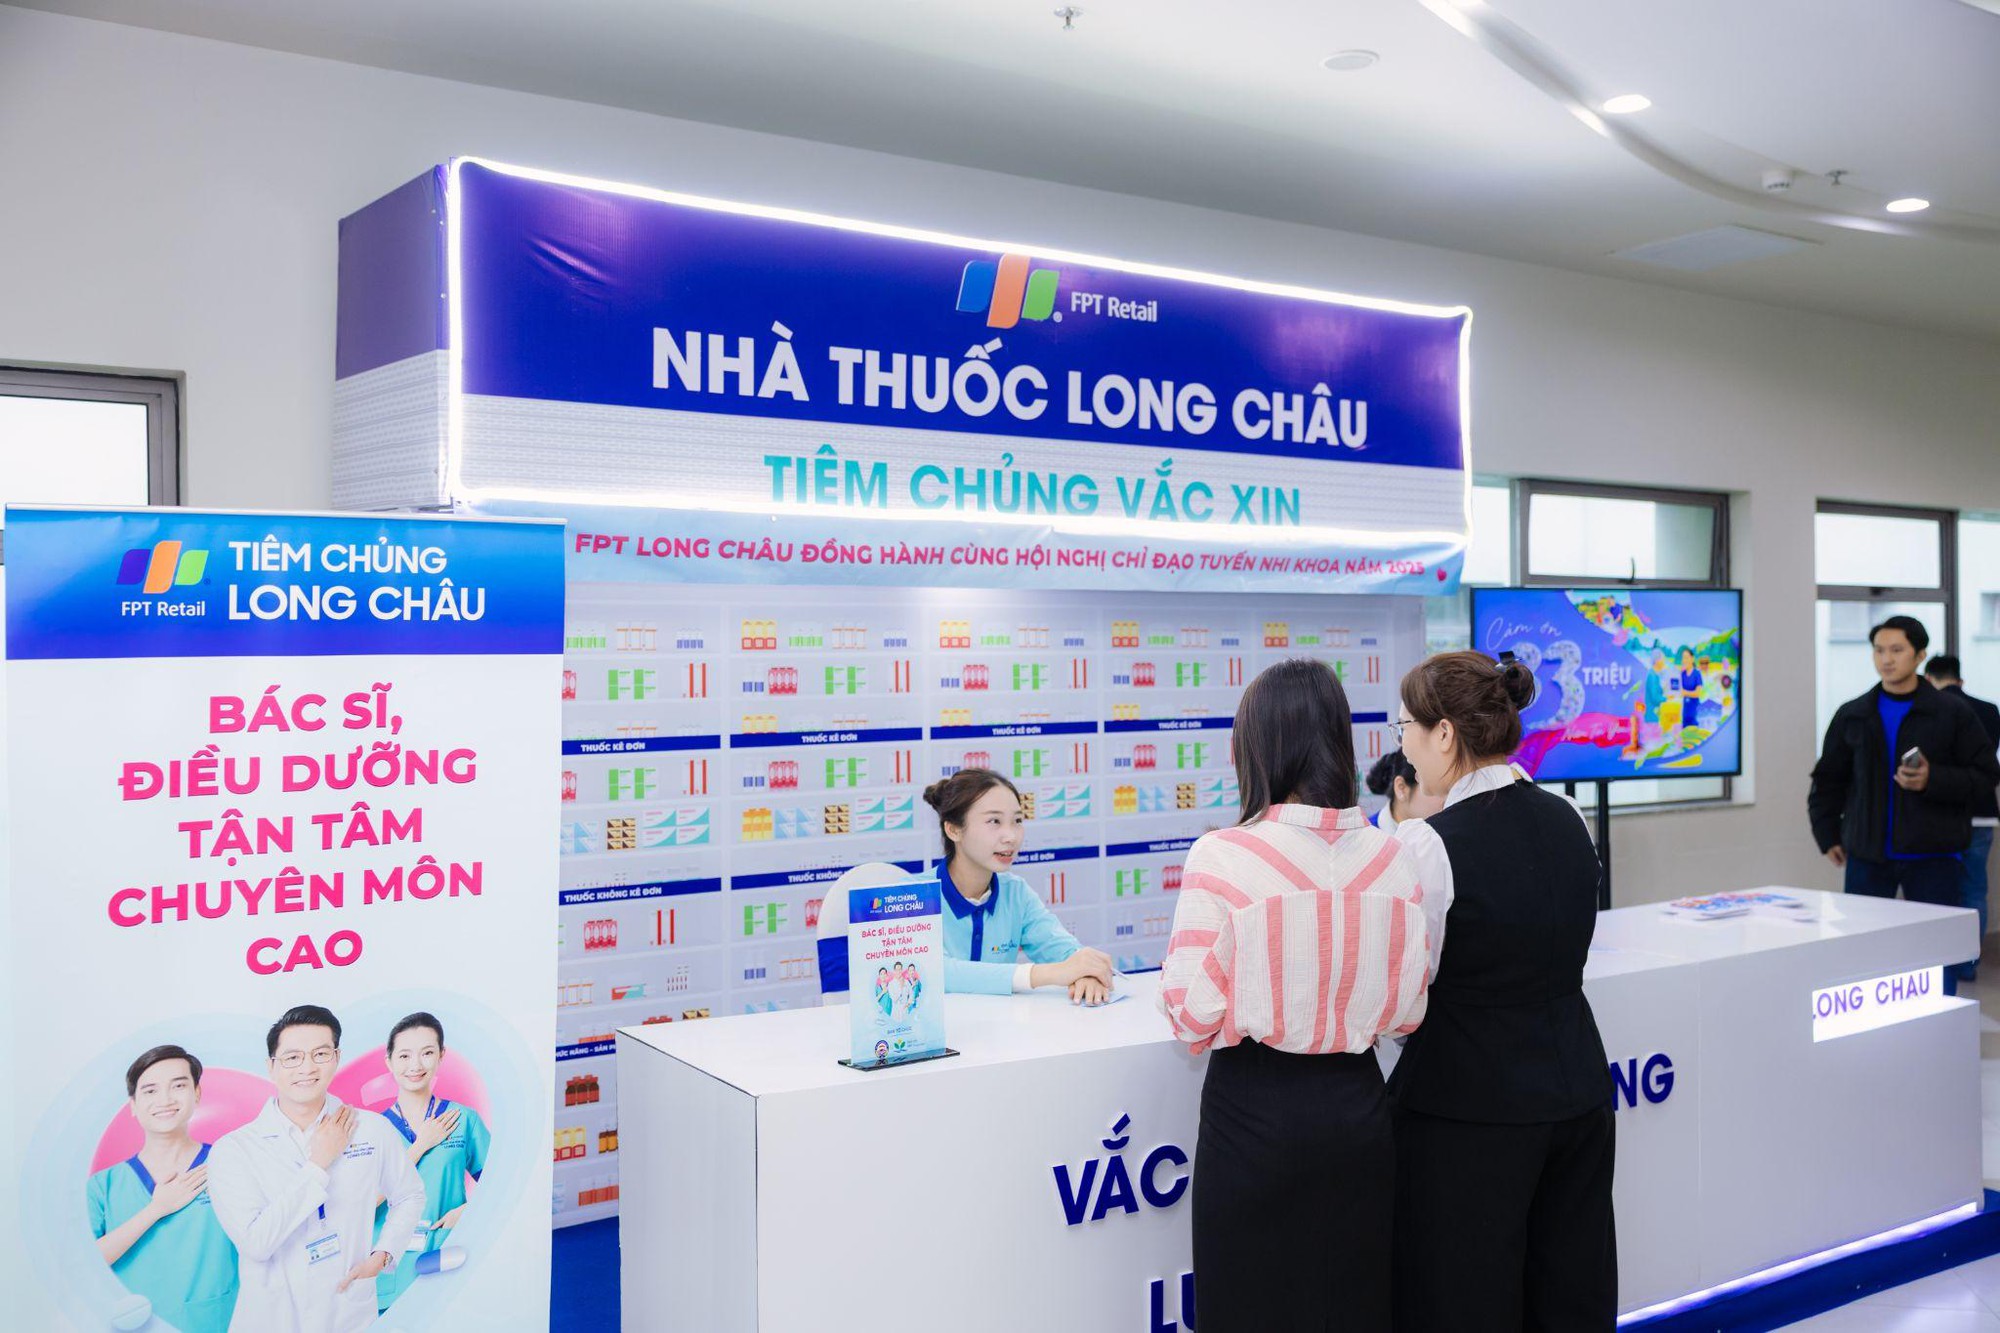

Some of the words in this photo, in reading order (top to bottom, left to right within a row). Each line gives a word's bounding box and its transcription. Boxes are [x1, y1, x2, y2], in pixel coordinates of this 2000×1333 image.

[1071, 291, 1104, 315] FPT
[1107, 296, 1158, 322] Retail
[653, 320, 809, 401] NHÀ
[829, 337, 1048, 421] THUỐC
[1067, 370, 1217, 435] LONG
[1232, 382, 1368, 448] CHÂU
[764, 444, 888, 509] TIÊM
[909, 453, 1099, 515] CHỦNG
[1116, 457, 1213, 522] VẮC
[1230, 484, 1300, 526] XIN
[228, 534, 311, 572] TIÊM
[321, 536, 447, 574] CHỦNG
[575, 533, 629, 555] FPT
[637, 536, 709, 558] LONG
[718, 537, 793, 563] CHÂU
[800, 538, 872, 564] ĐỒNG
[880, 541, 943, 565] HÀNH
[951, 542, 1008, 566] CÙNG
[1016, 544, 1050, 570] HỘI
[1057, 548, 1105, 571] NGHỊ
[1112, 546, 1148, 569] CHỈ
[1152, 551, 1194, 575] ĐẠO
[1200, 549, 1257, 571] TUYẾN
[1259, 557, 1290, 572] NHI
[1294, 557, 1340, 574] KHOA
[1345, 557, 1384, 575] NĂM
[121, 602, 152, 616] FPT
[158, 601, 206, 616] Retail
[228, 584, 357, 621] LONG
[368, 577, 485, 621] CHÂU
[1582, 661, 1631, 690] TRIỆU
[209, 684, 327, 734] BÁC
[342, 682, 403, 735] SĨ,
[581, 741, 611, 752] THUỐC
[612, 741, 625, 751] KÊ
[625, 740, 646, 750] ĐƠN
[801, 733, 828, 743] THUỐC
[118, 744, 261, 801] ĐIỀU
[282, 741, 477, 793] DƯỠNG
[178, 808, 293, 867] TẬN
[312, 801, 423, 850] TÂM
[108, 866, 344, 927] CHUYÊN
[363, 855, 483, 905] MÔN
[564, 890, 595, 902] THUỐC
[597, 888, 628, 900] KHÔNG
[629, 887, 641, 897] KÊ
[642, 886, 662, 896] ĐƠN
[788, 872, 814, 883] THUỐC
[884, 904, 904, 913] LONG
[246, 930, 363, 975] CAO
[1813, 986, 1864, 1020] ONG
[1875, 971, 1930, 1004] CHAU
[1610, 1053, 1674, 1111] NG
[1052, 1112, 1190, 1226] VẮC
